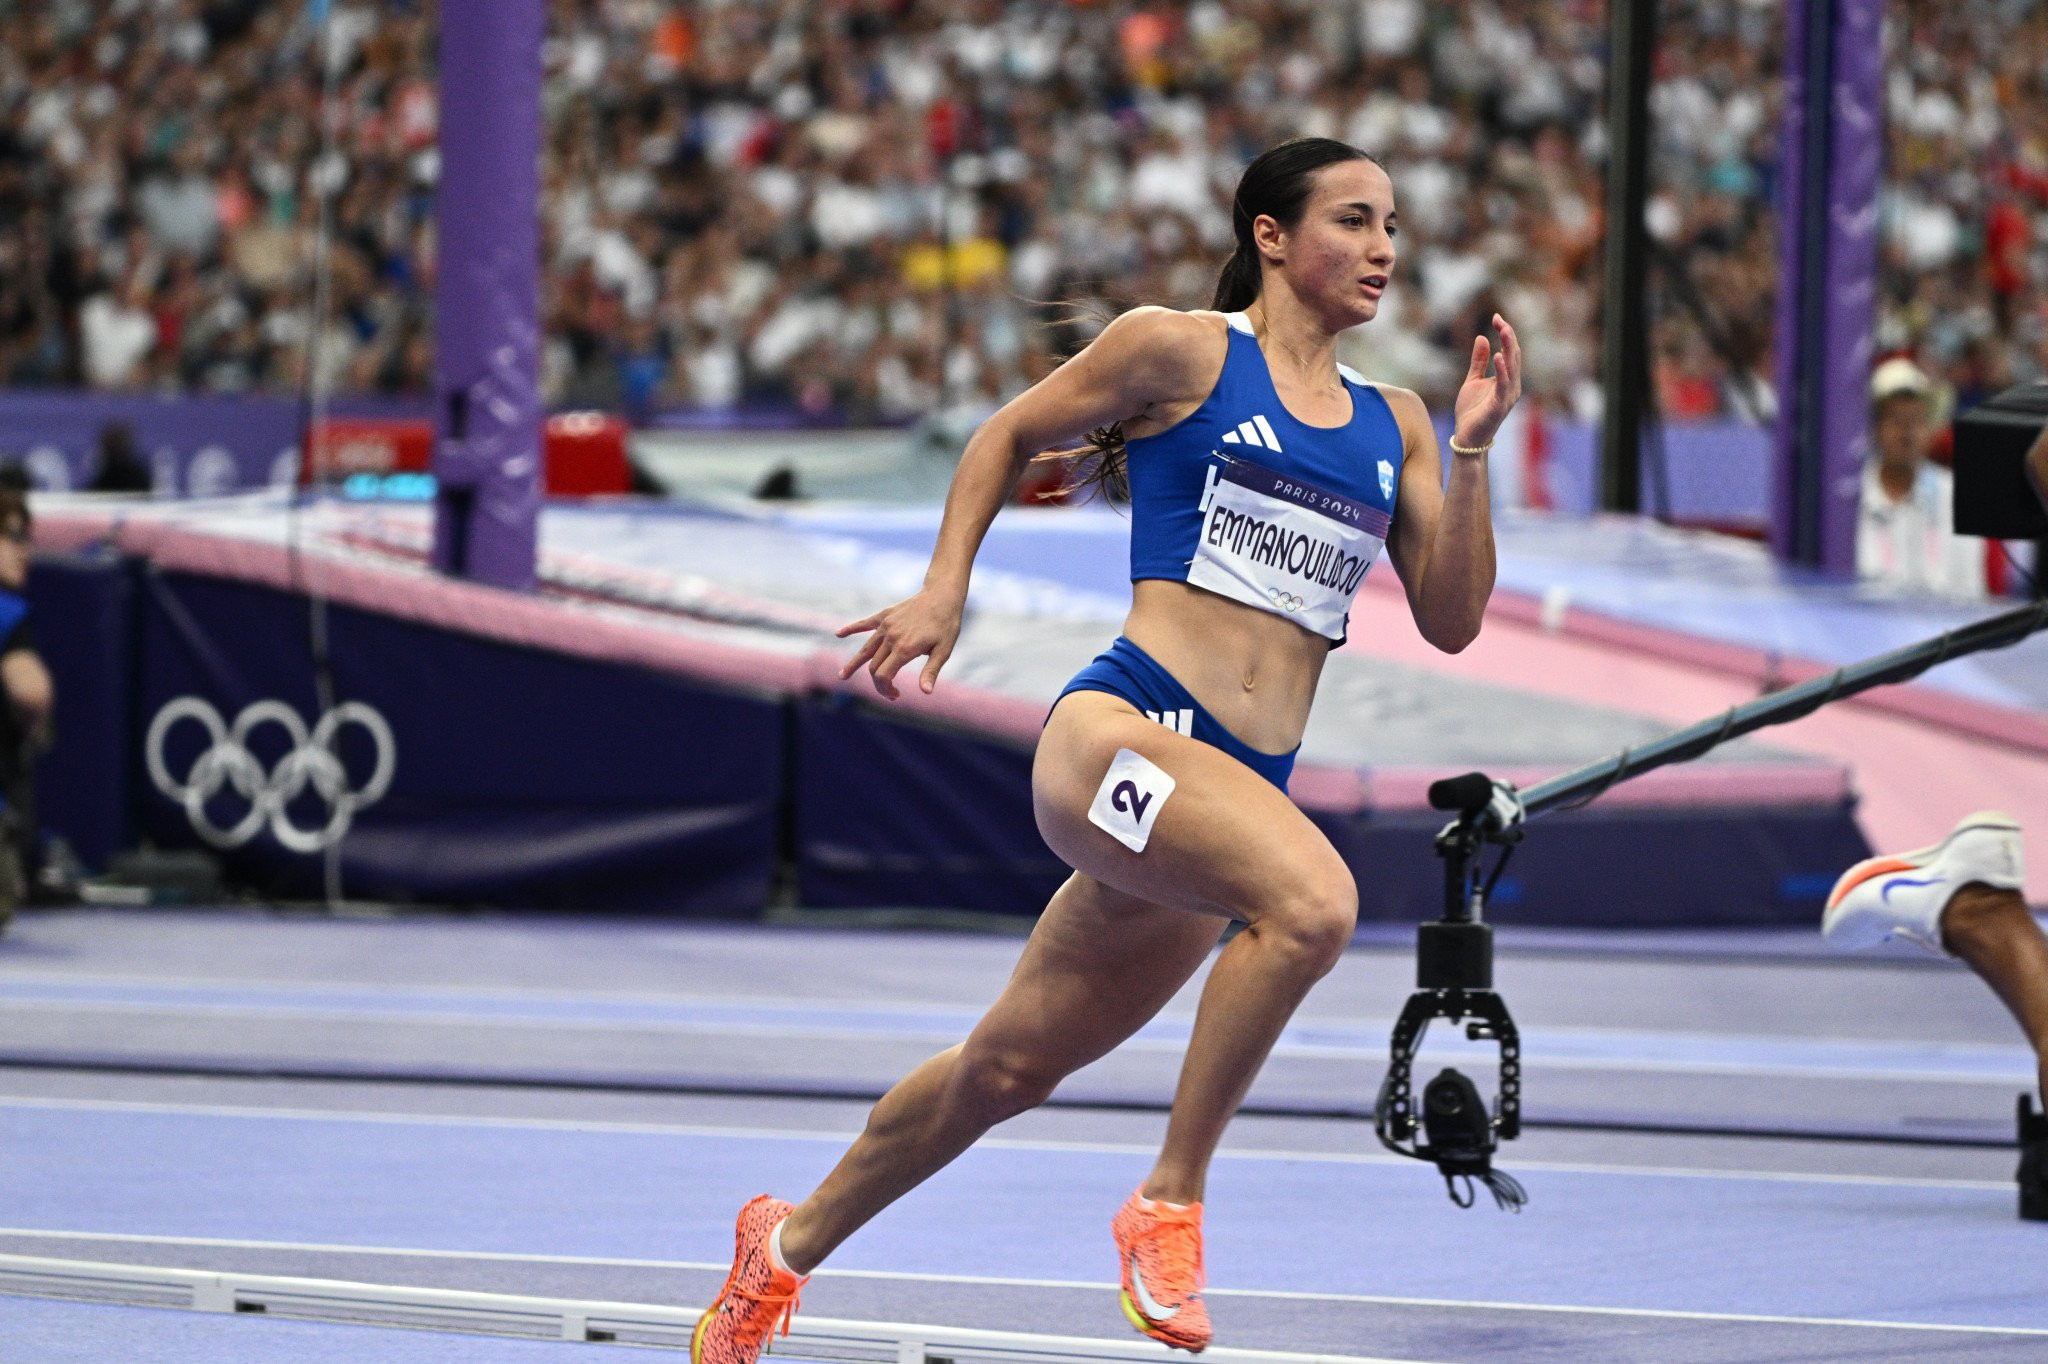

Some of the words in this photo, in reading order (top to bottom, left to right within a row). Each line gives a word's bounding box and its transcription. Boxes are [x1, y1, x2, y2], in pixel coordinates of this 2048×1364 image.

[1274, 480, 1317, 503] PARIS
[1321, 497, 1360, 520] 2024
[1207, 505, 1371, 596] EMMANOUILIDOU
[1111, 779, 1153, 825] 2
